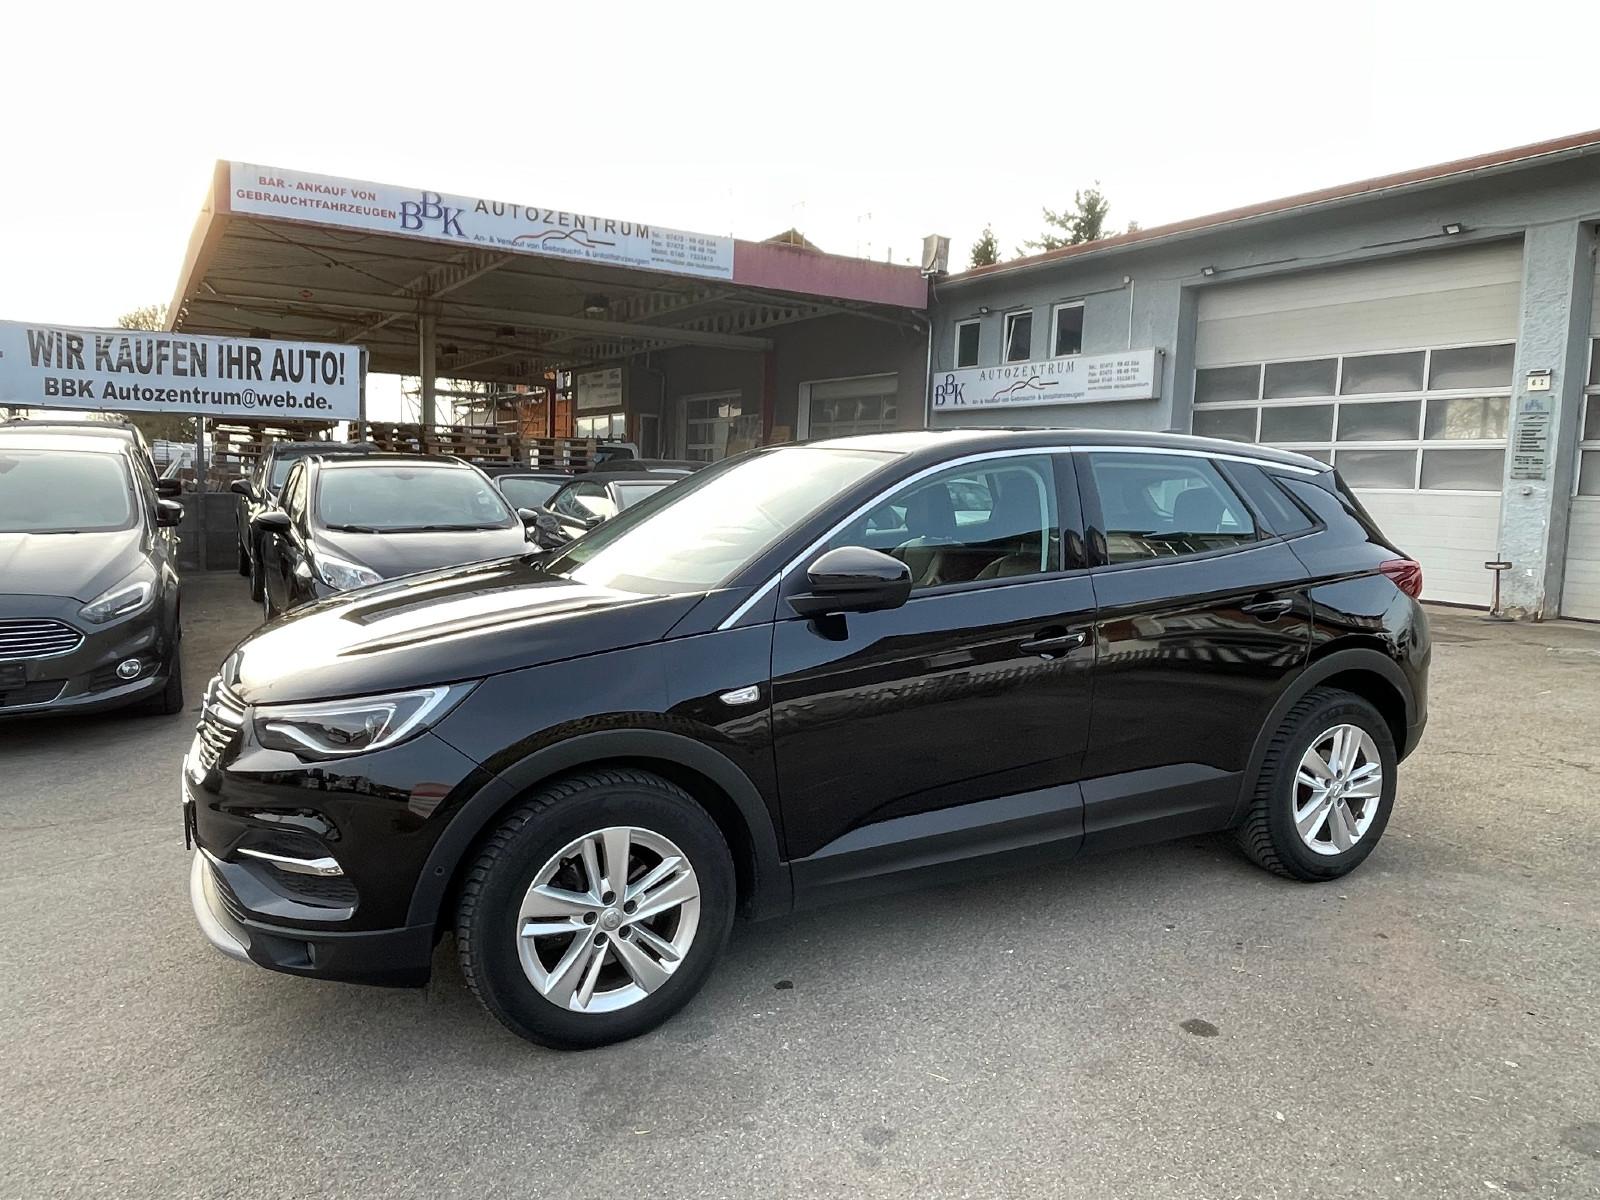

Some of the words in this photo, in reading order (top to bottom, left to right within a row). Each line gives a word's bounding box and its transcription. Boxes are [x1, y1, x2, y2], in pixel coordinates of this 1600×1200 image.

[236, 189, 397, 220] GEBRAUCHTFAHRZEUGEN
[258, 176, 285, 189] BAR
[296, 181, 348, 197] ANKAUF
[351, 190, 377, 201] VON
[399, 191, 467, 237] BBK
[474, 199, 650, 240] AUTOZENTRUM
[26, 329, 85, 371] WIR
[95, 334, 208, 378] KAUFEN
[217, 343, 263, 382] IHR
[270, 347, 346, 386] AUTO!
[979, 361, 1076, 381] AUTOZENTRUM
[44, 377, 95, 399] BBK
[102, 380, 333, 410] Autozentrum@web.de.
[934, 374, 967, 406] BBK
